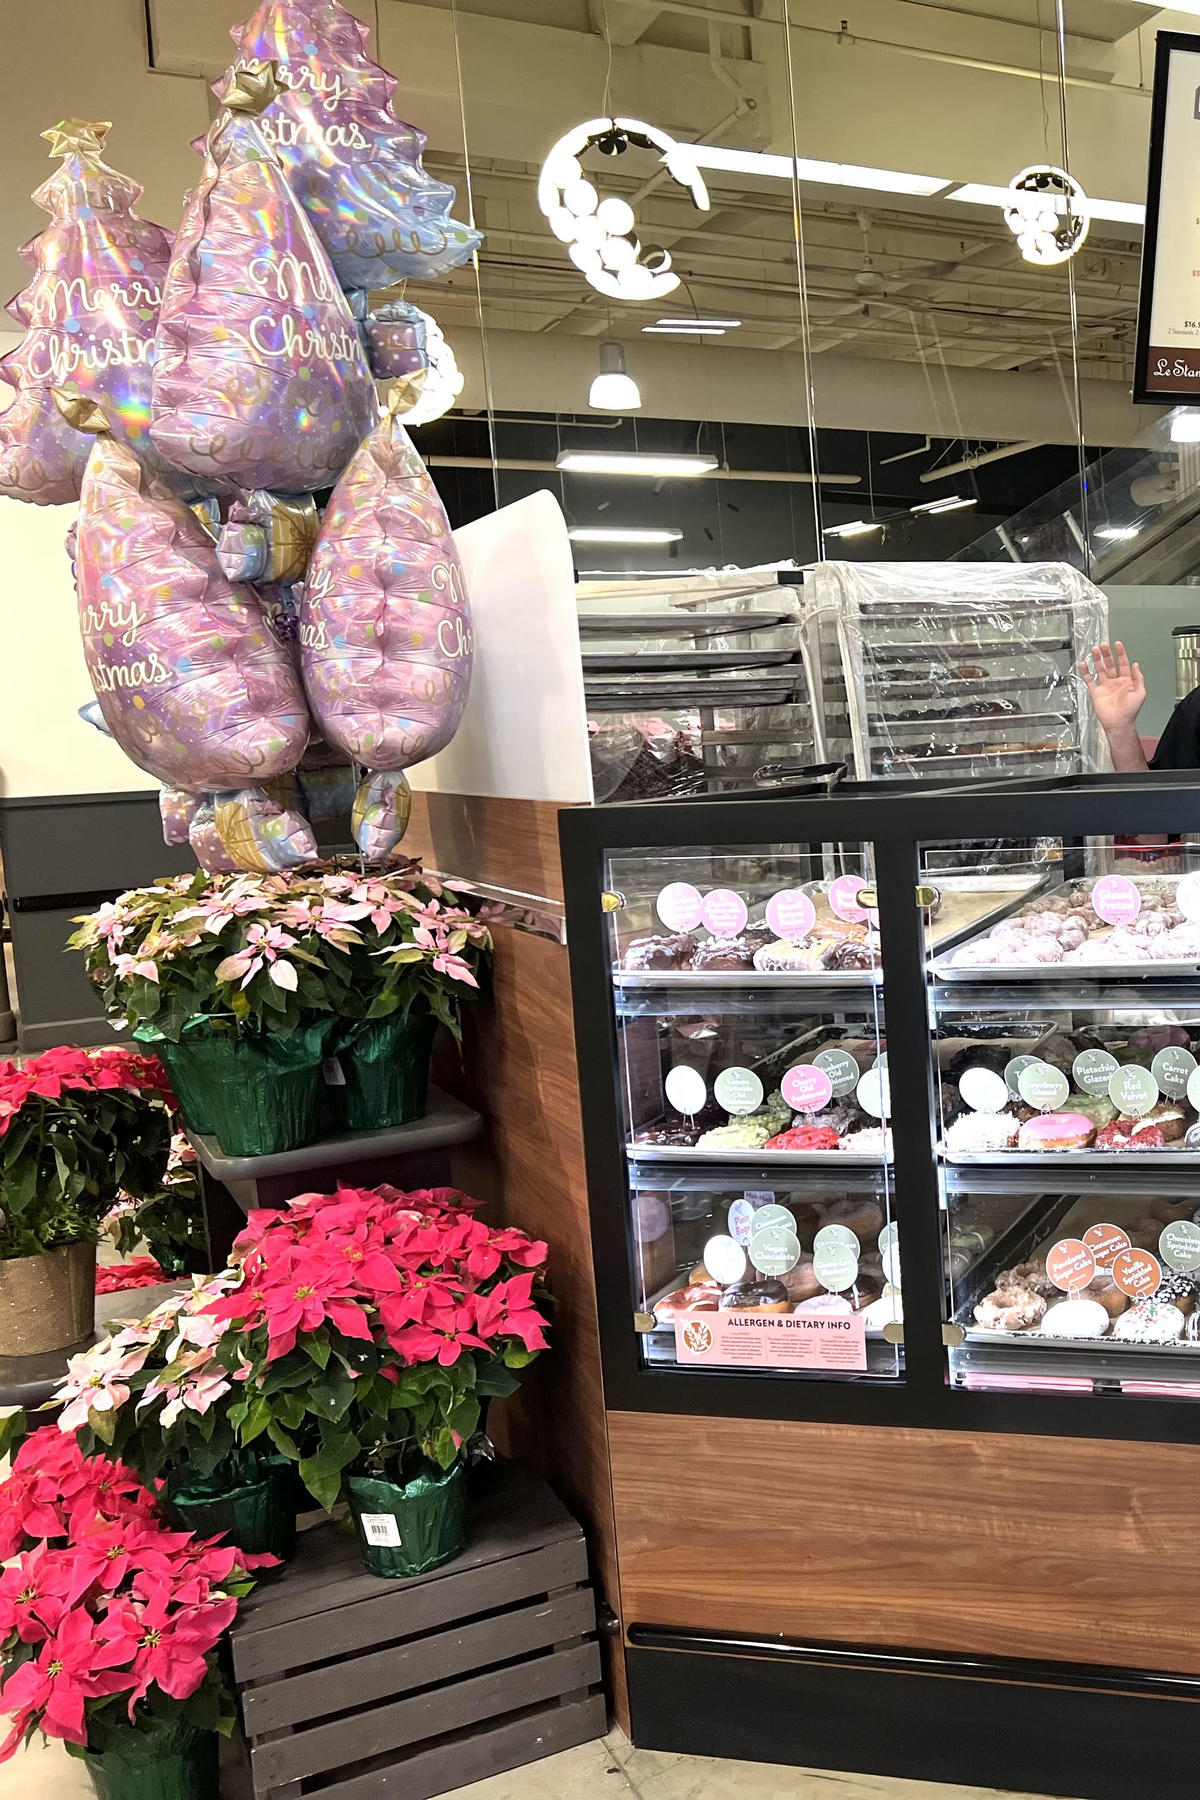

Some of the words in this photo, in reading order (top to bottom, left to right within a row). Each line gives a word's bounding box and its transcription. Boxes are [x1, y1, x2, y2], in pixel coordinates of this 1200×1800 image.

[260, 112, 371, 150] stmas
[1153, 358, 1171, 376] Le
[83, 600, 146, 647] erry
[92, 653, 173, 692] stmas
[1076, 1064, 1115, 1075] Pistachio
[1163, 1063, 1189, 1075] Carrot
[1084, 1073, 1113, 1084] Glazed
[1164, 1073, 1183, 1084] Cake
[801, 1084, 814, 1092] Old
[1124, 1082, 1141, 1091] Red
[1120, 1091, 1148, 1101] Velvet
[728, 1319, 774, 1327] ALLERGEN
[786, 1320, 825, 1329] DIETARY
[828, 1322, 850, 1330] INFO
